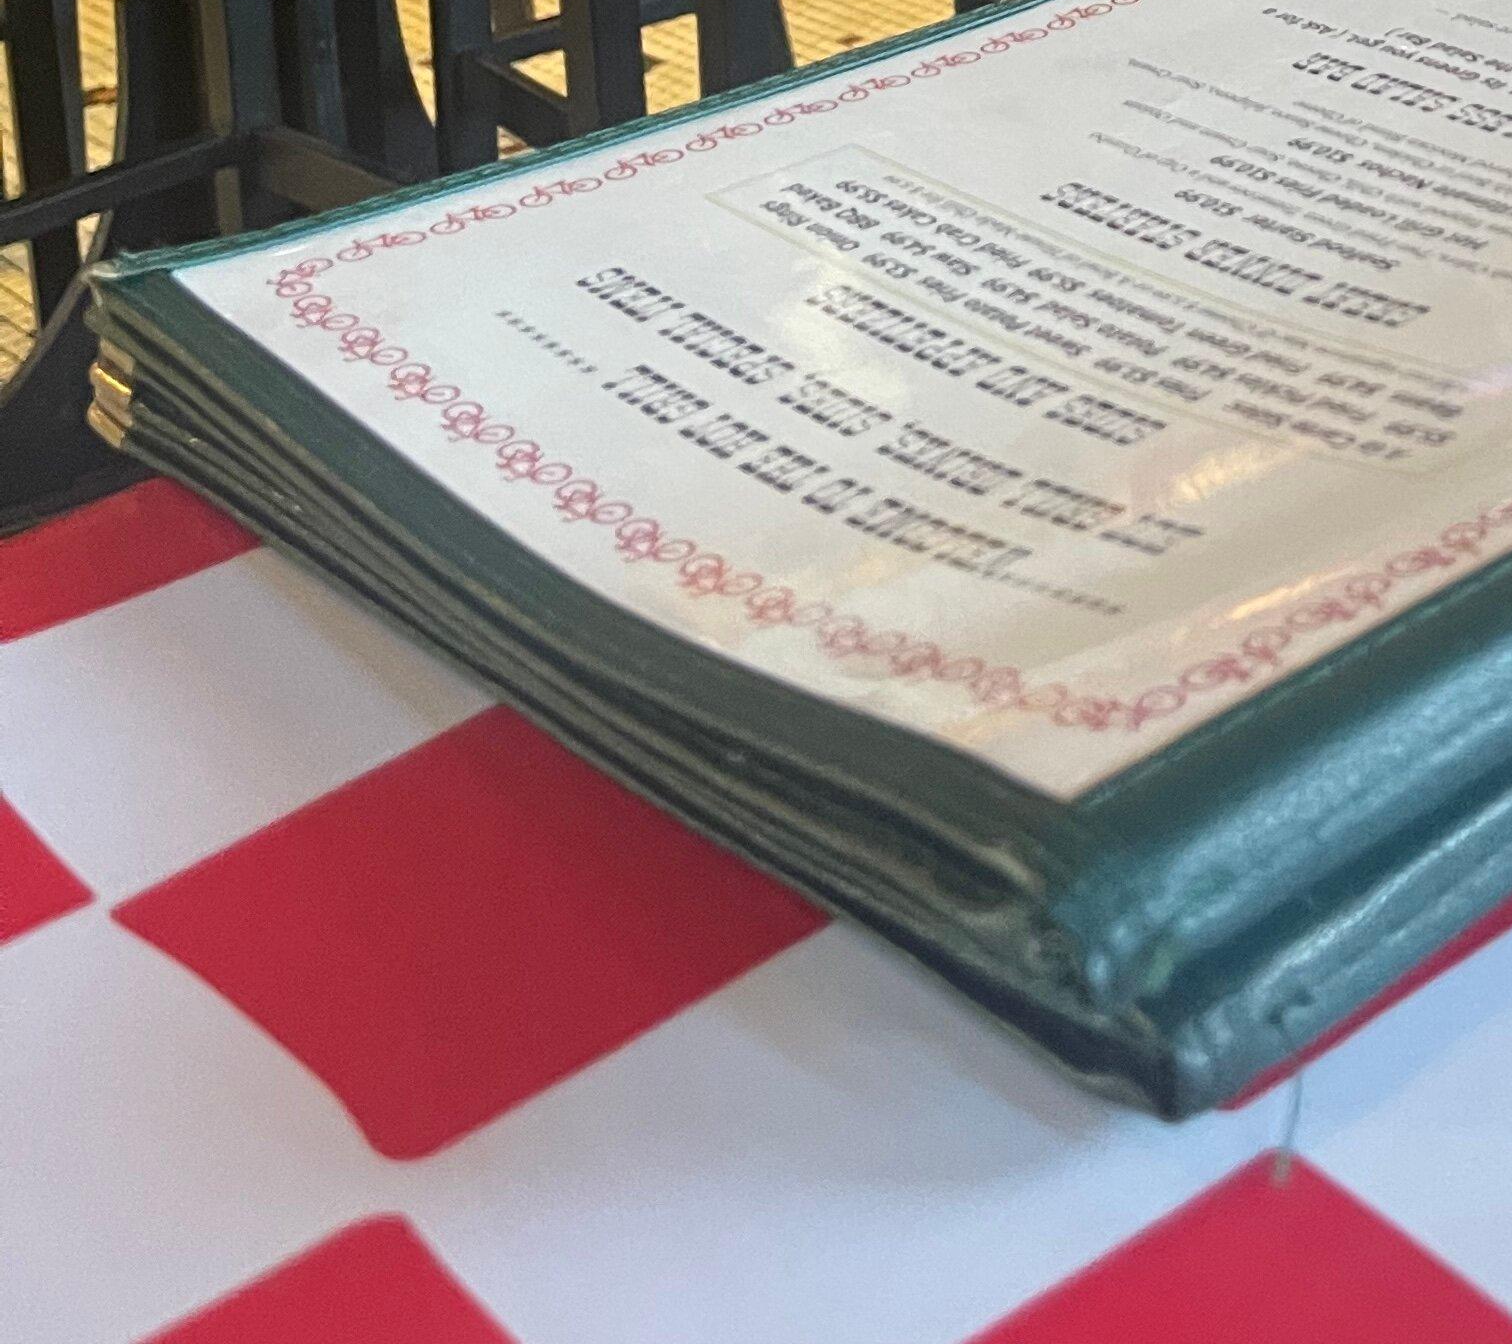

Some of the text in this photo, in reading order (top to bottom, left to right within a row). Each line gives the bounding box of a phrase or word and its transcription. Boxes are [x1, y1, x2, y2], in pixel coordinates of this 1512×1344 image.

[1275, 12, 1303, 26] for
[1380, 45, 1416, 61] you
[1428, 42, 1484, 63] Salad
[1293, 53, 1365, 82] BAR
[1416, 56, 1480, 82] Greens
[1352, 73, 1458, 113] SALAD
[1287, 138, 1354, 164] $10.99
[1209, 155, 1276, 182] $10.99
[1358, 160, 1432, 190] Nachos
[782, 183, 842, 213] Baked
[835, 180, 888, 205] $5.99
[1274, 176, 1323, 199] Fries
[761, 200, 810, 228] Rings
[883, 199, 938, 227] Cakes
[1042, 183, 1200, 250] STARTERS
[1174, 190, 1242, 217] $10.99
[1317, 193, 1397, 224] Loaded
[835, 207, 880, 230] BBQ
[1244, 215, 1314, 244] Starter
[1393, 218, 1445, 238] Grill
[806, 223, 860, 252] Onion
[880, 231, 936, 256] $4.99
[934, 223, 981, 247] Crab
[1443, 232, 1488, 252] Hot
[862, 253, 918, 280] $3.99
[932, 252, 980, 277] Slaw
[973, 242, 1029, 270] Fried
[1185, 240, 1321, 295] DINNER
[1308, 238, 1399, 271] Seafood
[577, 267, 684, 322] ITEMS
[917, 276, 966, 303] Fries
[980, 278, 1040, 305] $4.99
[1027, 268, 1085, 293] $5.99
[964, 298, 1029, 332] Potato
[1034, 300, 1099, 329] Salad
[1088, 289, 1183, 334] Tomatoes
[1303, 283, 1429, 327] GREAT
[660, 313, 793, 385] SPECIAL
[1024, 326, 1091, 358] Sweet
[1096, 323, 1167, 358] Potato
[1186, 328, 1251, 357] Green
[808, 286, 1165, 445] SIDES AND APPETIZERS
[1245, 350, 1309, 376] Fried
[604, 365, 709, 424] GRILL
[1155, 377, 1210, 403] Fries
[779, 374, 892, 436] SIDES,
[1307, 396, 1375, 424] Fried
[679, 414, 769, 459] HOT
[739, 445, 829, 493] THE
[879, 424, 1021, 495] DRINKS,
[1003, 479, 1124, 532] GRILL
[847, 499, 1028, 575] WELCOME
